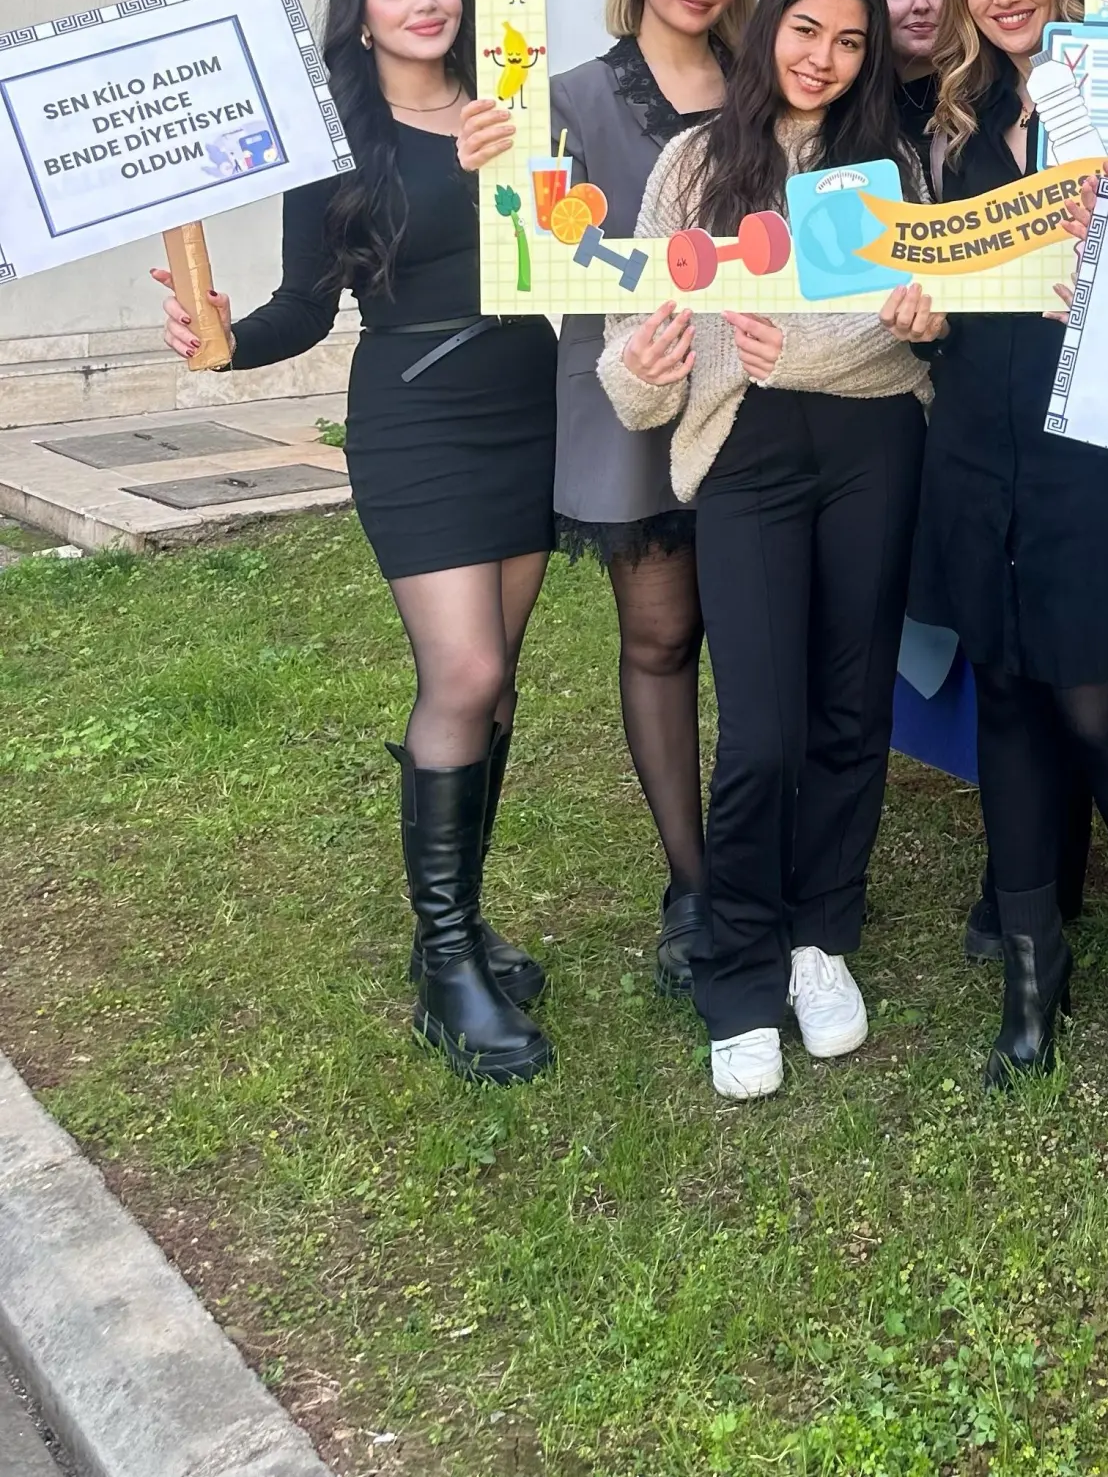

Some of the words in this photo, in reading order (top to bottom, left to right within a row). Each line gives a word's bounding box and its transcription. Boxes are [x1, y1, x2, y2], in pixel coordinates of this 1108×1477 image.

[43, 94, 90, 120] SEN
[93, 78, 146, 107] KİLO
[152, 56, 223, 91] ALDIM
[92, 92, 193, 134] DEYİNCE
[44, 140, 123, 177] BENDE
[126, 99, 255, 152] DİYETİSYEN
[121, 141, 205, 180] OLDUM
[895, 211, 981, 241] TOROS
[890, 230, 1015, 264] BESLENME
